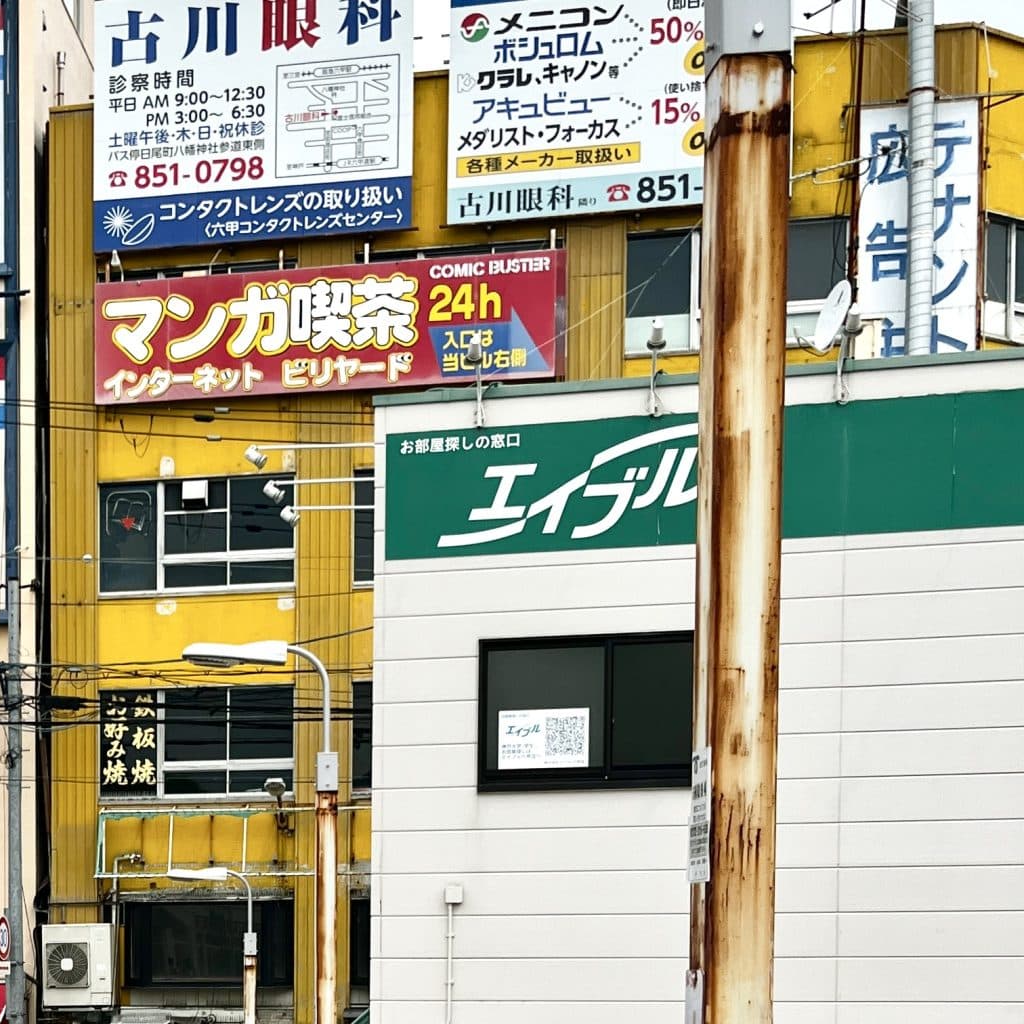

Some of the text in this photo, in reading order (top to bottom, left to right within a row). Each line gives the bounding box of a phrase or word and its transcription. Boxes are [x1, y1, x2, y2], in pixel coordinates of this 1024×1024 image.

[105, 0, 401, 67] 古川眼科
[494, 4, 624, 35] メニコン
[650, 16, 704, 45] 50%
[494, 31, 603, 63] ボシュロム
[109, 70, 194, 94] 診察時間
[109, 97, 136, 113] 平日
[143, 95, 169, 110] AM
[146, 112, 169, 127] PM
[473, 91, 610, 124] アキュビュー
[651, 97, 700, 125] 15%
[457, 119, 620, 151] メダリスト・フォーカス
[134, 156, 265, 189] 851-0798
[467, 148, 631, 173] 各種メーカー取扱い
[159, 186, 403, 221] コンタクトレンズの取り扱い
[457, 184, 574, 218] 古川眼科
[429, 257, 551, 279] COMIC BUSTER
[104, 274, 416, 363] マンガ喫茶
[428, 283, 502, 322] 24h
[104, 353, 413, 398] インターネット ビリヤード
[400, 433, 520, 454] お部屋探しの窓口
[437, 422, 698, 548] エイブル
